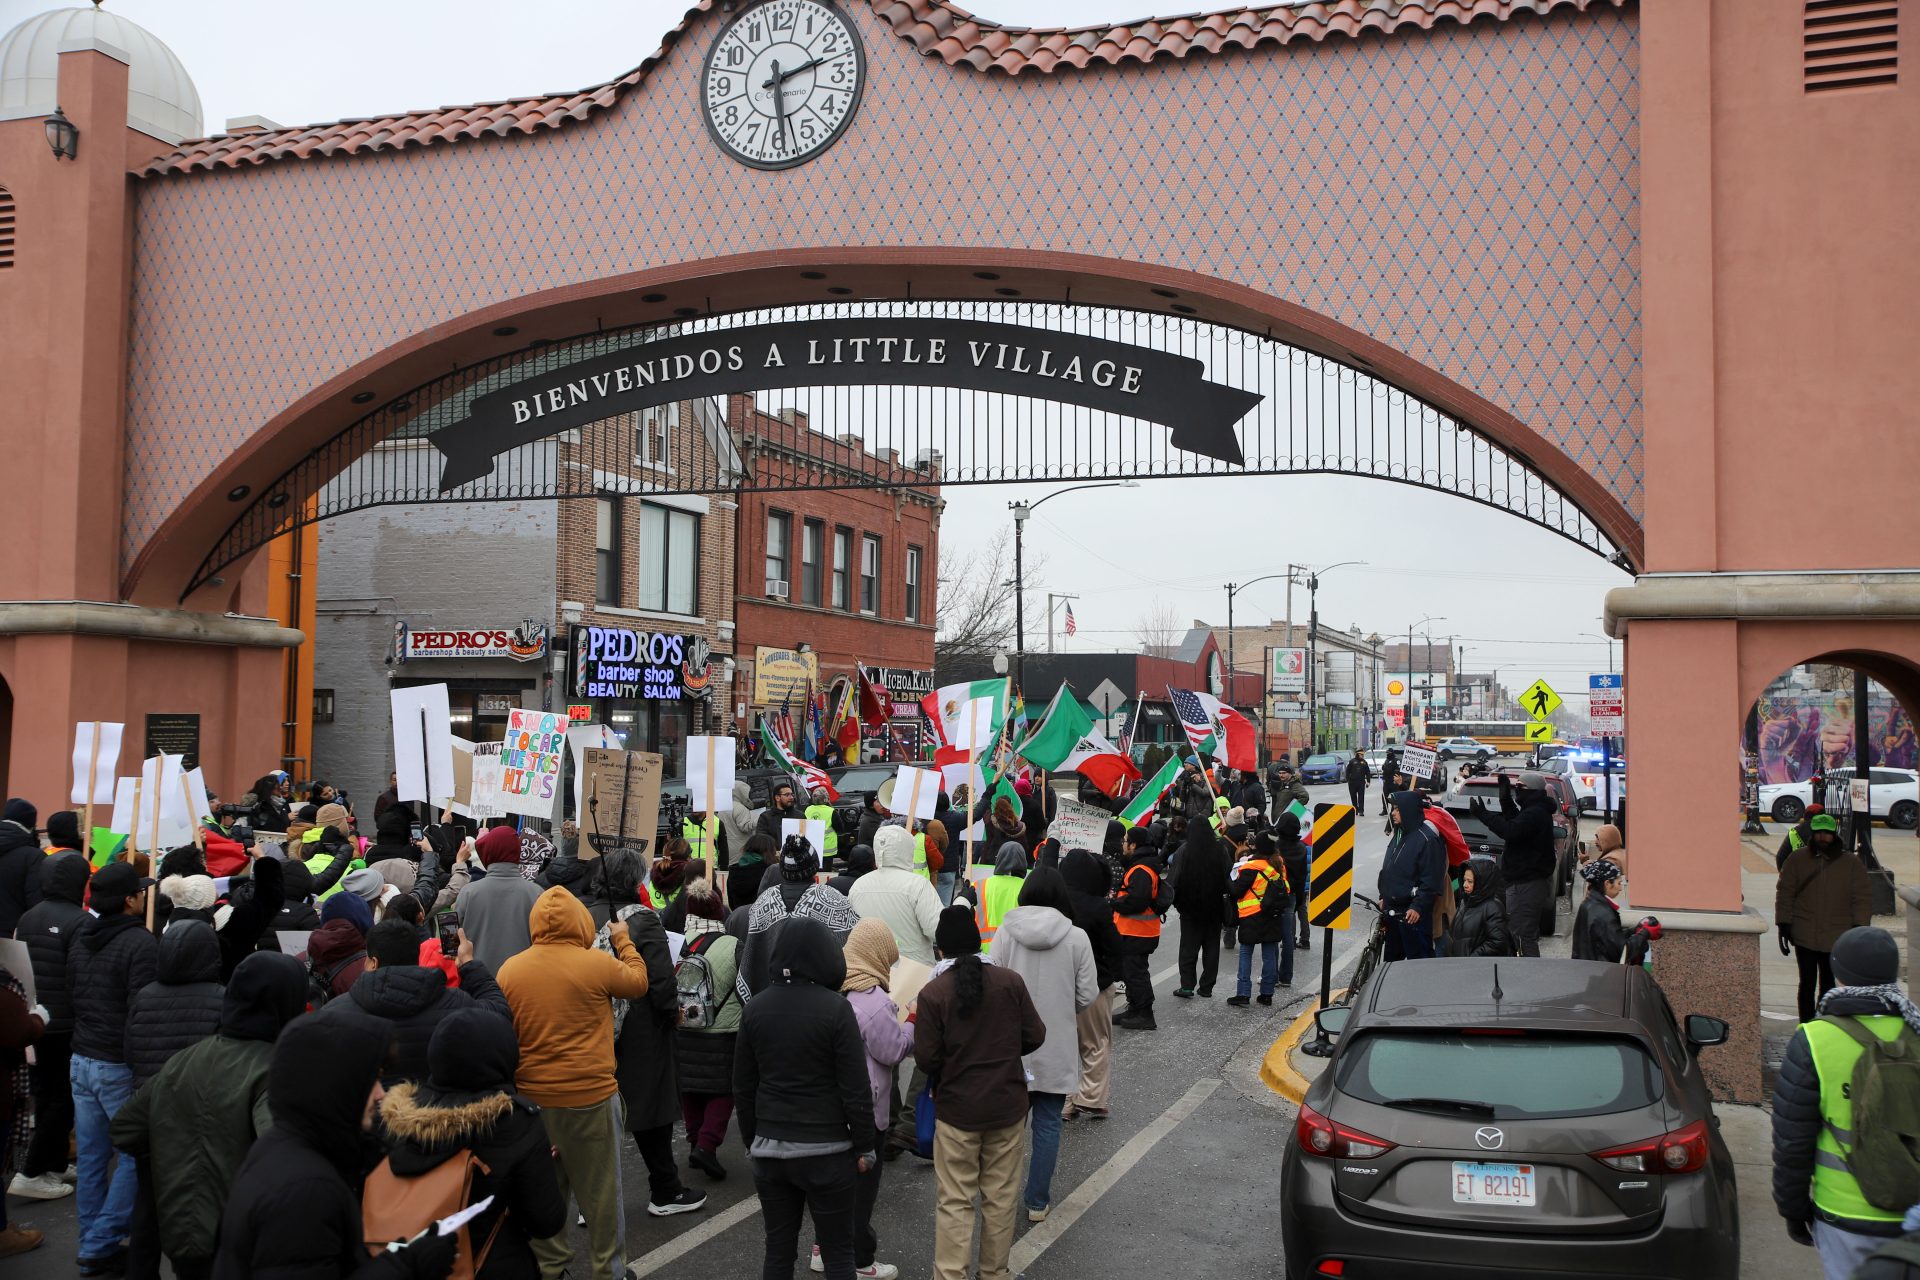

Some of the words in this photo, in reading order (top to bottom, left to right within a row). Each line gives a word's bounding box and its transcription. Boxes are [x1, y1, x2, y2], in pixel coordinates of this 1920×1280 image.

[748, 21, 761, 43] 11
[772, 10, 794, 32] 12
[806, 14, 813, 35] 1
[822, 32, 838, 54] 2
[726, 45, 744, 67] 10
[830, 62, 846, 84] 3
[716, 76, 731, 97] 9
[820, 94, 836, 115] 4
[724, 105, 739, 127] 8
[747, 124, 762, 144] 7
[800, 117, 815, 140] 5
[771, 129, 787, 151] 6
[512, 345, 745, 425] BIENVENIDOS
[764, 342, 785, 368] A
[808, 337, 947, 366] LITTLE
[968, 341, 1142, 395] VILLAGE
[411, 630, 507, 649] PEDRO'S
[587, 627, 684, 666] PEDRO'S
[414, 648, 453, 657] barbershop
[462, 649, 486, 657] beauty
[597, 661, 641, 682] barber
[644, 665, 675, 686] shop
[588, 683, 639, 698] BEAUTY
[644, 685, 681, 700] SALON
[488, 701, 511, 710] 3121
[568, 705, 591, 720] OPEN
[896, 704, 918, 715] CREAM
[525, 713, 555, 733] NO
[508, 730, 562, 754] TOCAR
[500, 749, 559, 775] NUESTROS
[1404, 755, 1421, 763] RIGHTS
[1406, 749, 1434, 760] IMMIGRANT
[1402, 764, 1415, 773] FOR
[1416, 768, 1431, 776] ALL!
[502, 768, 553, 799] HIJOS
[1457, 1174, 1475, 1195] ET
[1484, 1175, 1530, 1197] 82191
